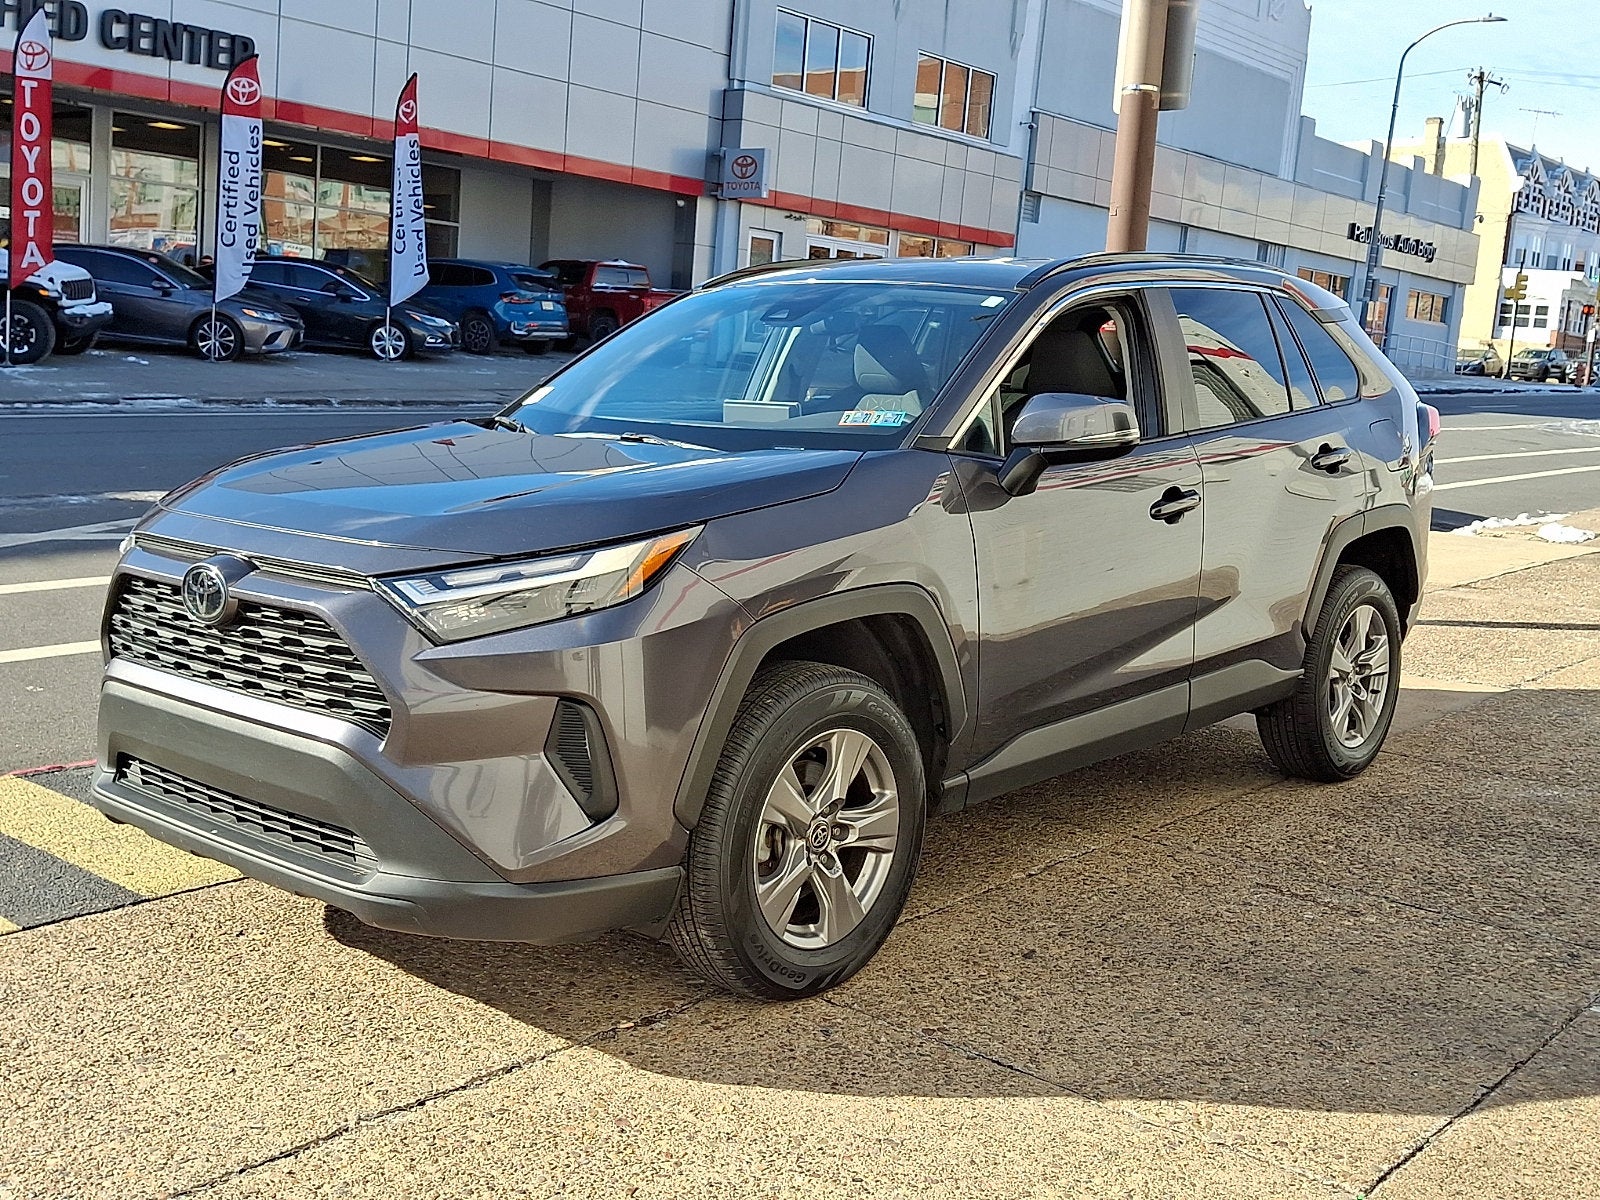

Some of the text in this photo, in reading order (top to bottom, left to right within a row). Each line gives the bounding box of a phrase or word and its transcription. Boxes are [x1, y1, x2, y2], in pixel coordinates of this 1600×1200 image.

[101, 9, 255, 70] CENTER
[20, 79, 46, 268] TOYOTA
[220, 150, 240, 248] Certified
[244, 124, 260, 216] Vehicles
[406, 139, 423, 223] Vehicles
[725, 181, 761, 191] TOYOTA
[1395, 234, 1418, 255] Auto
[1418, 239, 1437, 263] Body
[843, 414, 851, 424] 2
[873, 413, 903, 424] 2 27
